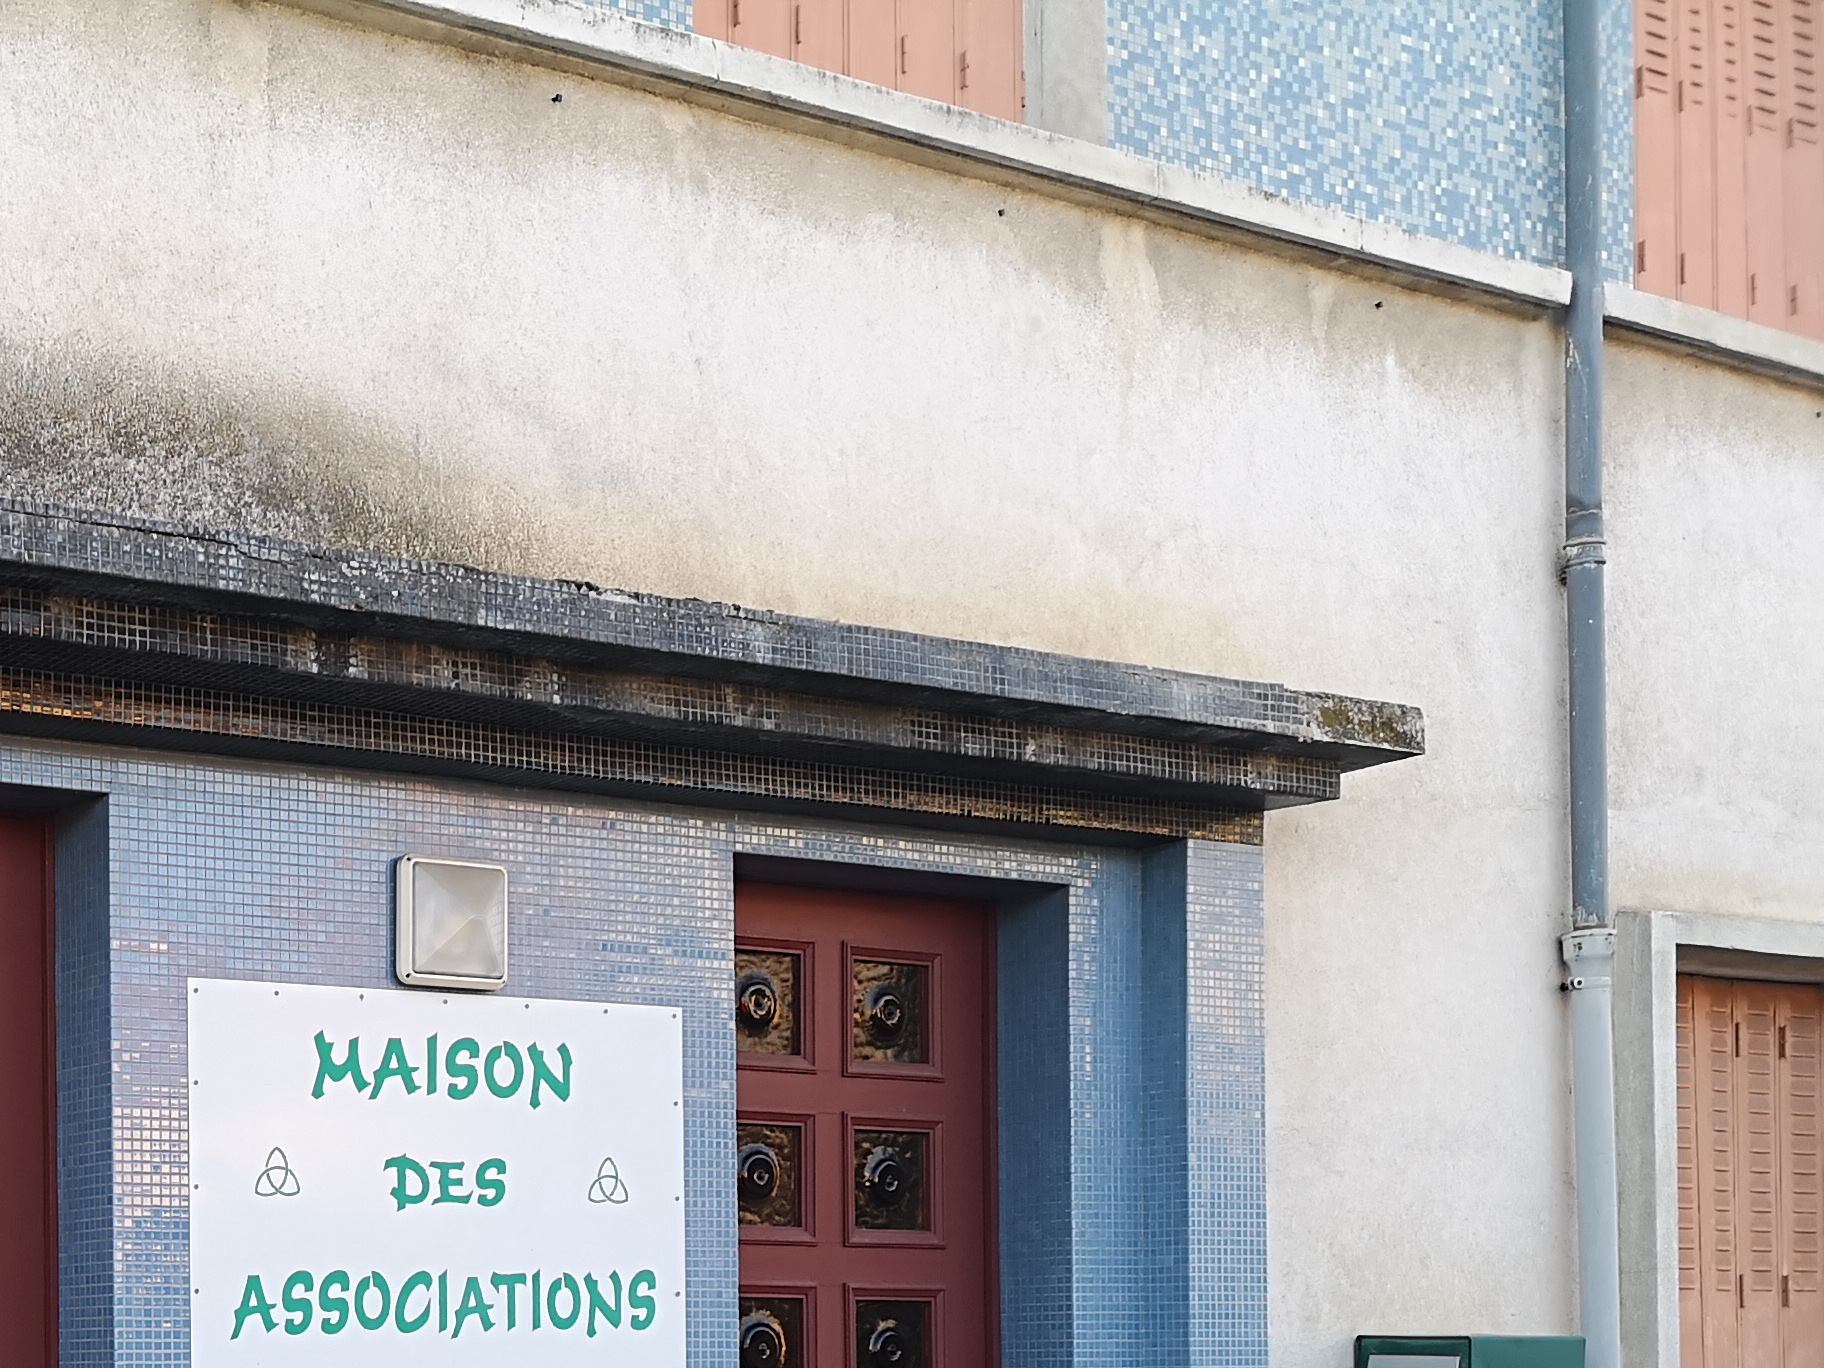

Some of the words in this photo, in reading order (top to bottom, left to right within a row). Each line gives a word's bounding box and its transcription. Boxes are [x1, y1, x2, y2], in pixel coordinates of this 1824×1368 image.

[311, 1030, 573, 1109] MAISON
[383, 1154, 507, 1211] DES
[230, 1269, 656, 1339] ASSOCIATIONS
